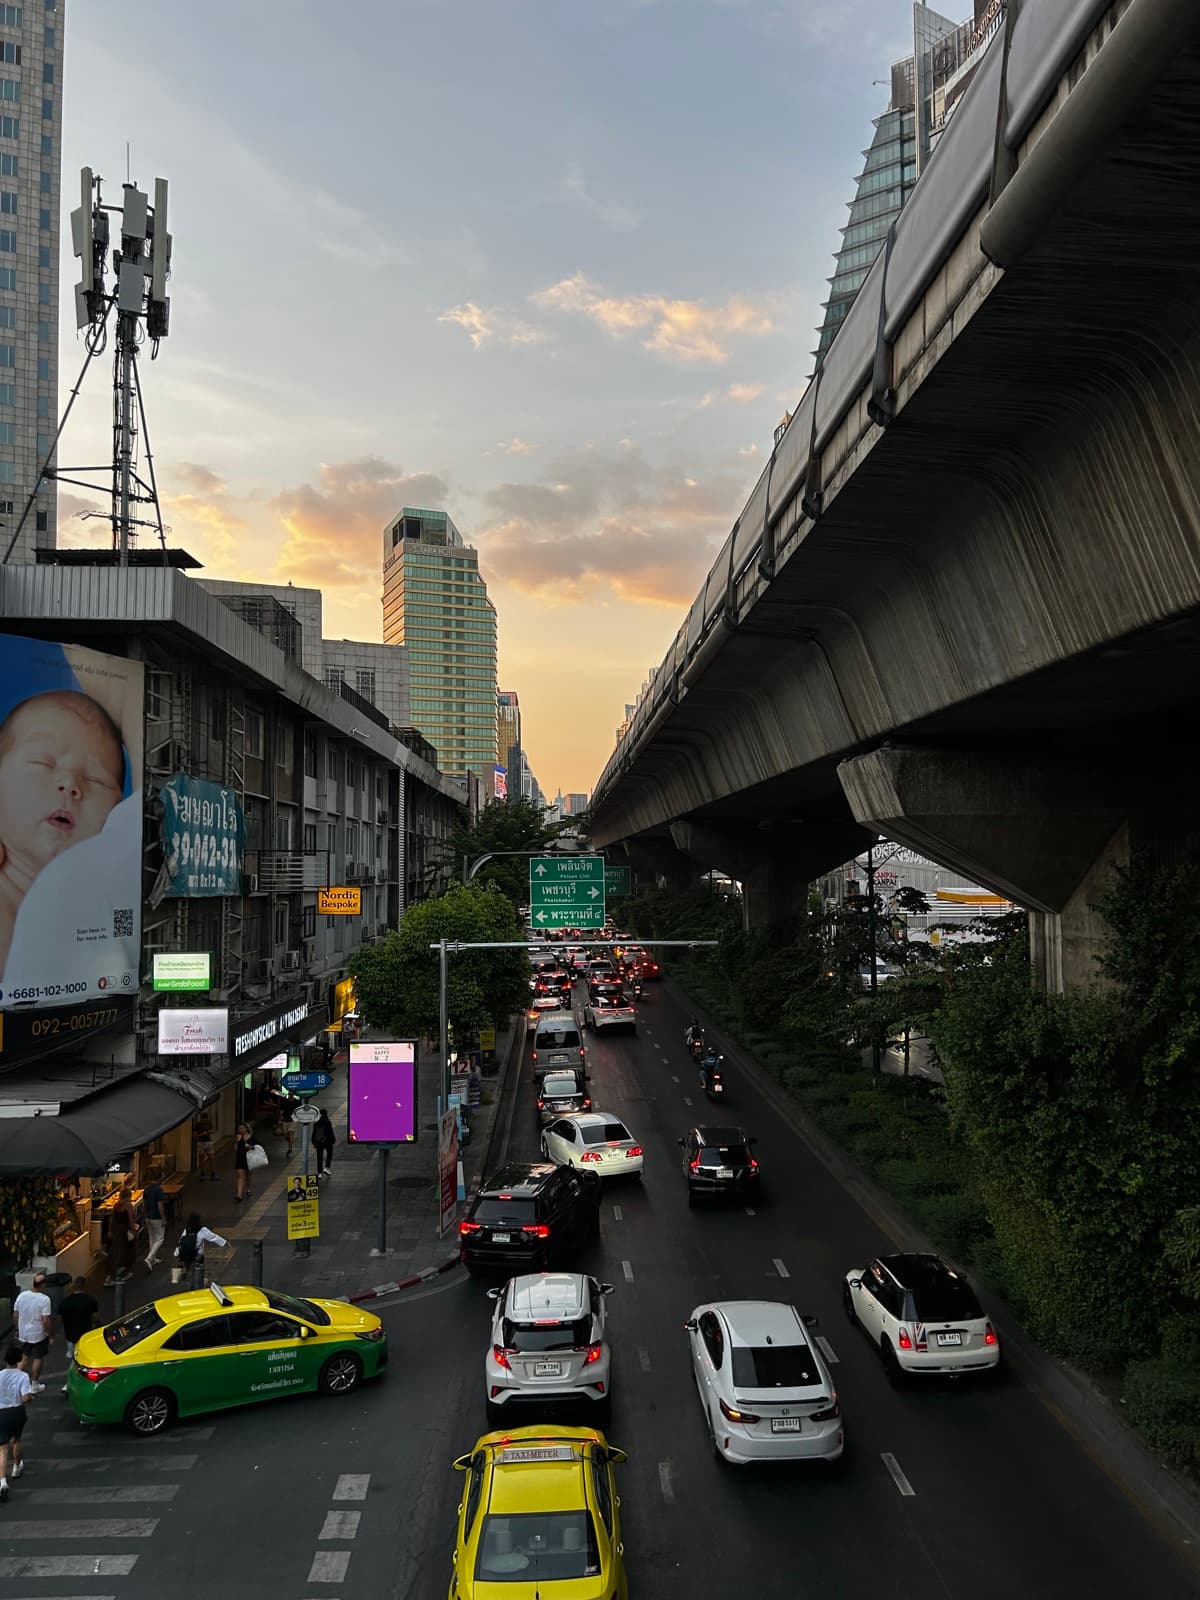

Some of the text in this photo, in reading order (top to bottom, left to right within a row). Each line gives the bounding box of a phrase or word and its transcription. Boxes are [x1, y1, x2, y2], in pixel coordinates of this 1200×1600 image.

[557, 860, 593, 872] เพลินจิต
[321, 891, 359, 900] Nordic
[542, 882, 576, 898] เพชรบุรี
[321, 900, 359, 909] Bespoke
[551, 905, 602, 920] พระรามที่ ๔
[8, 982, 87, 999] +6681-102-1000
[32, 1009, 118, 1036] 092-0057777
[184, 1025, 203, 1035] Fresh
[452, 1060, 469, 1074] 12
[318, 1074, 326, 1084] 18
[307, 1188, 318, 1197] 49
[510, 1449, 560, 1461] TAXI-METER
